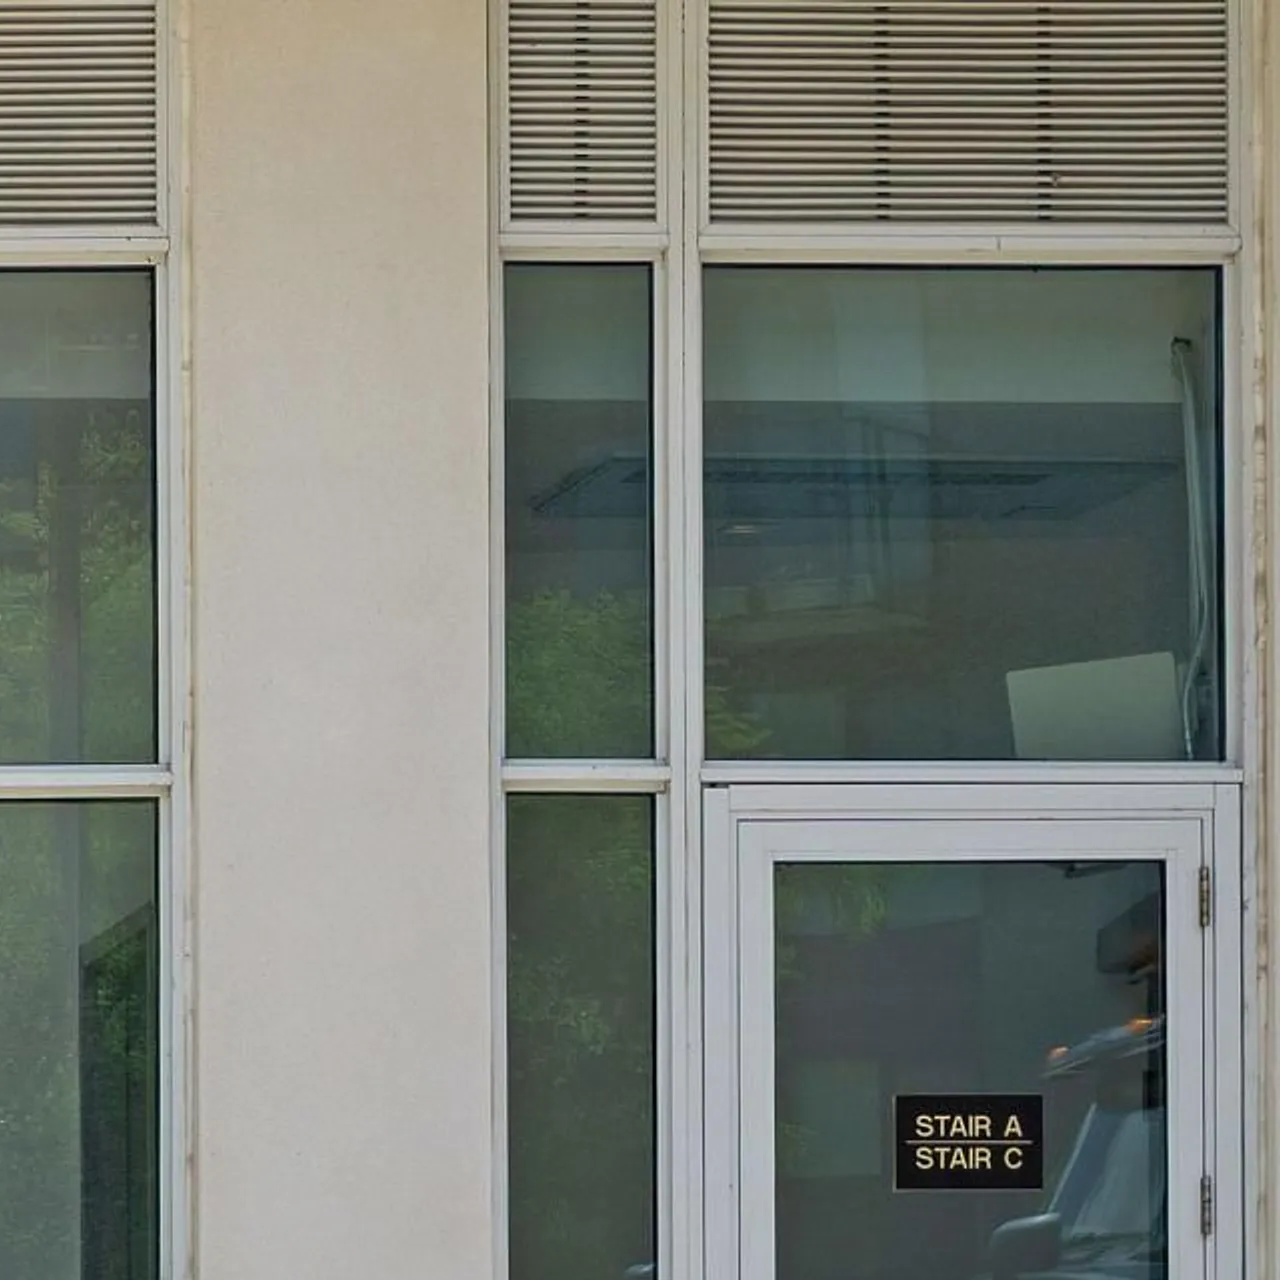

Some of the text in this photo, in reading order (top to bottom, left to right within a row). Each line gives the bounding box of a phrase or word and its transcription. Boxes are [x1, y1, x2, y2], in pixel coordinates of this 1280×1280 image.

[915, 1115, 1023, 1137] STAIR A
[915, 1147, 1023, 1170] STAIR C
